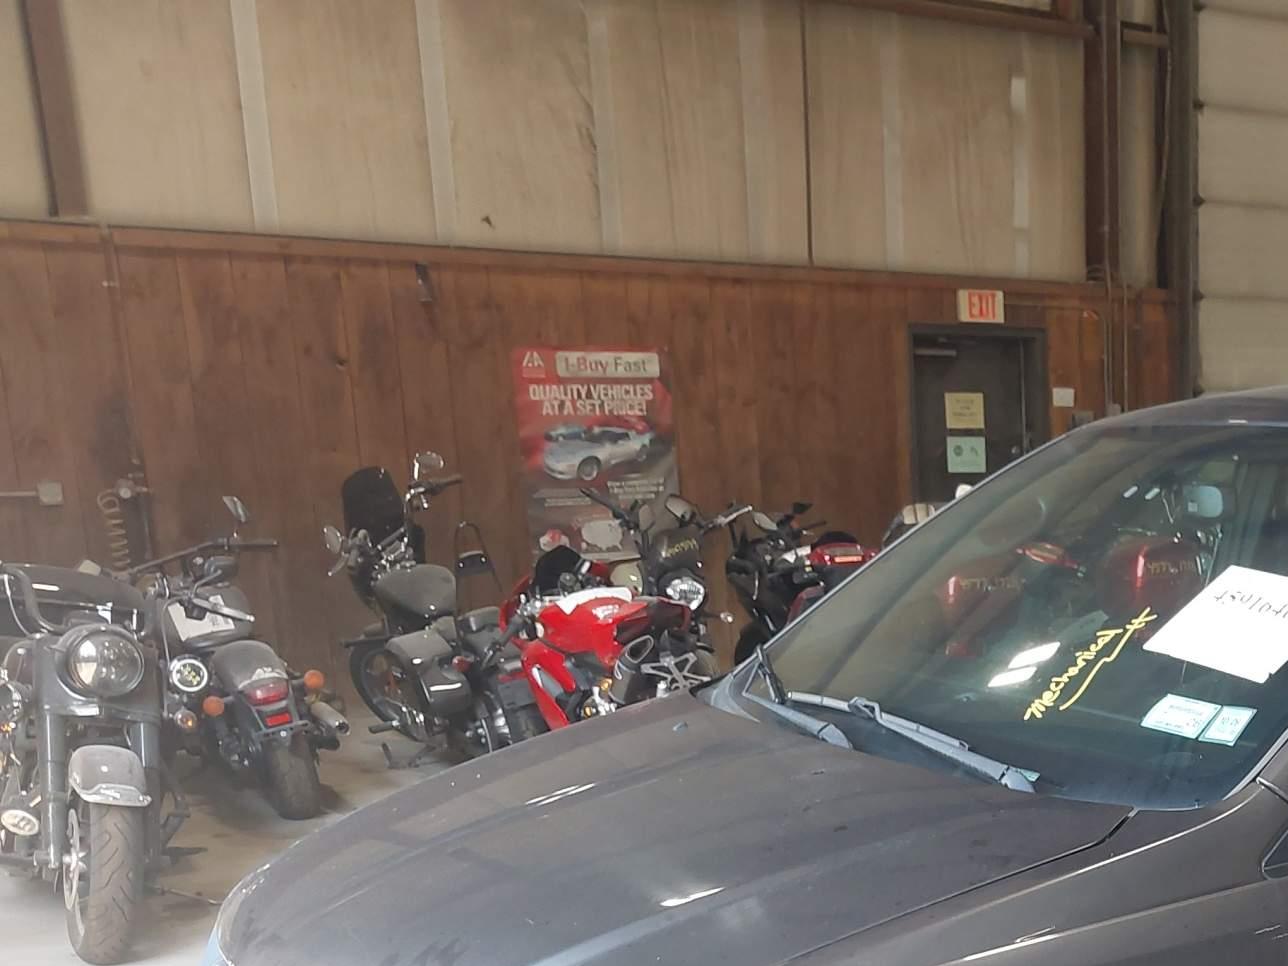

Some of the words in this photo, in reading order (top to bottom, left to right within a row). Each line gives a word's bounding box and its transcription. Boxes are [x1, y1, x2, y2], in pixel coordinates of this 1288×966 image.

[967, 291, 997, 320] EXIT
[564, 356, 609, 374] I-Buy
[613, 356, 647, 372] Fast
[528, 384, 588, 400] QUALITY
[590, 384, 653, 400] VEHICLES
[542, 399, 562, 416] AT
[562, 400, 575, 415] A
[576, 400, 601, 416] SET
[603, 400, 647, 416] PRICE!
